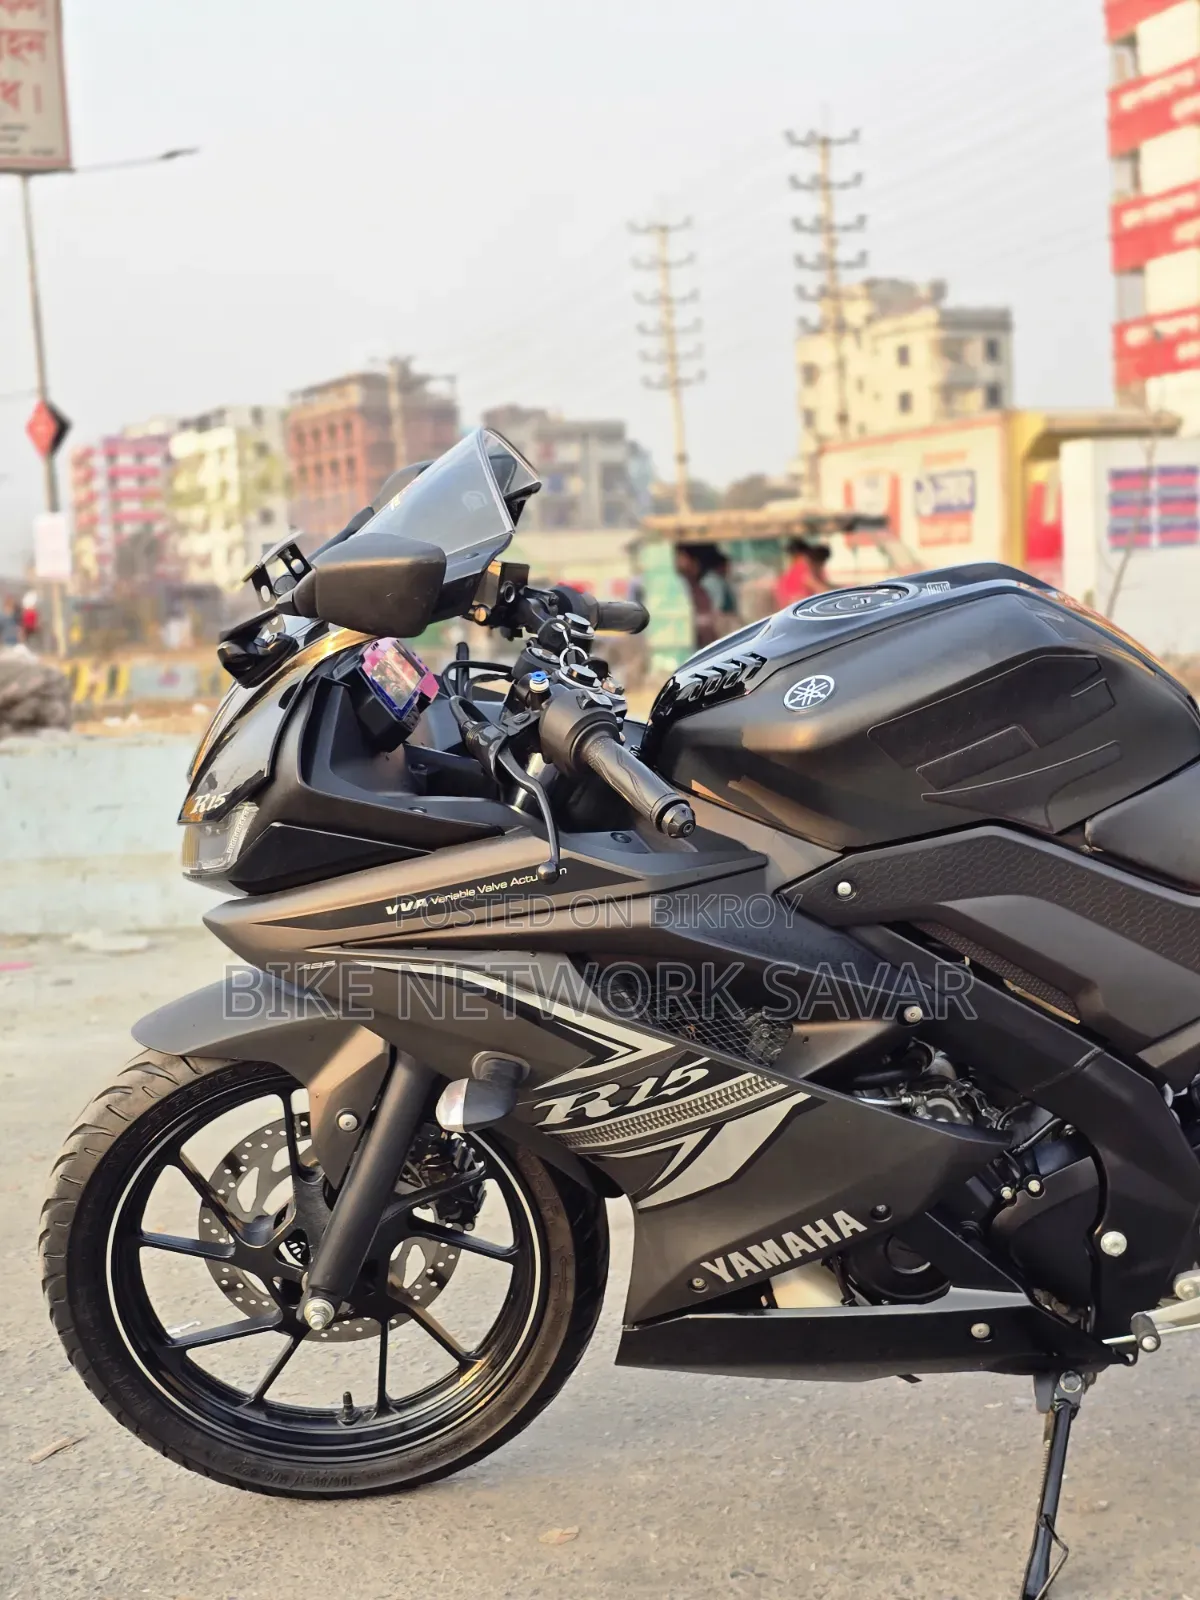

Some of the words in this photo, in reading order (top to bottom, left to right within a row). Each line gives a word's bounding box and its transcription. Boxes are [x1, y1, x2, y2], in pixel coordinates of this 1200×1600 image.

[190, 791, 231, 815] R15
[430, 889, 476, 905] Variable
[477, 881, 508, 894] Valve
[510, 867, 567, 887] Actun
[533, 1057, 711, 1127] R15
[700, 1210, 868, 1284] YAMAHA
